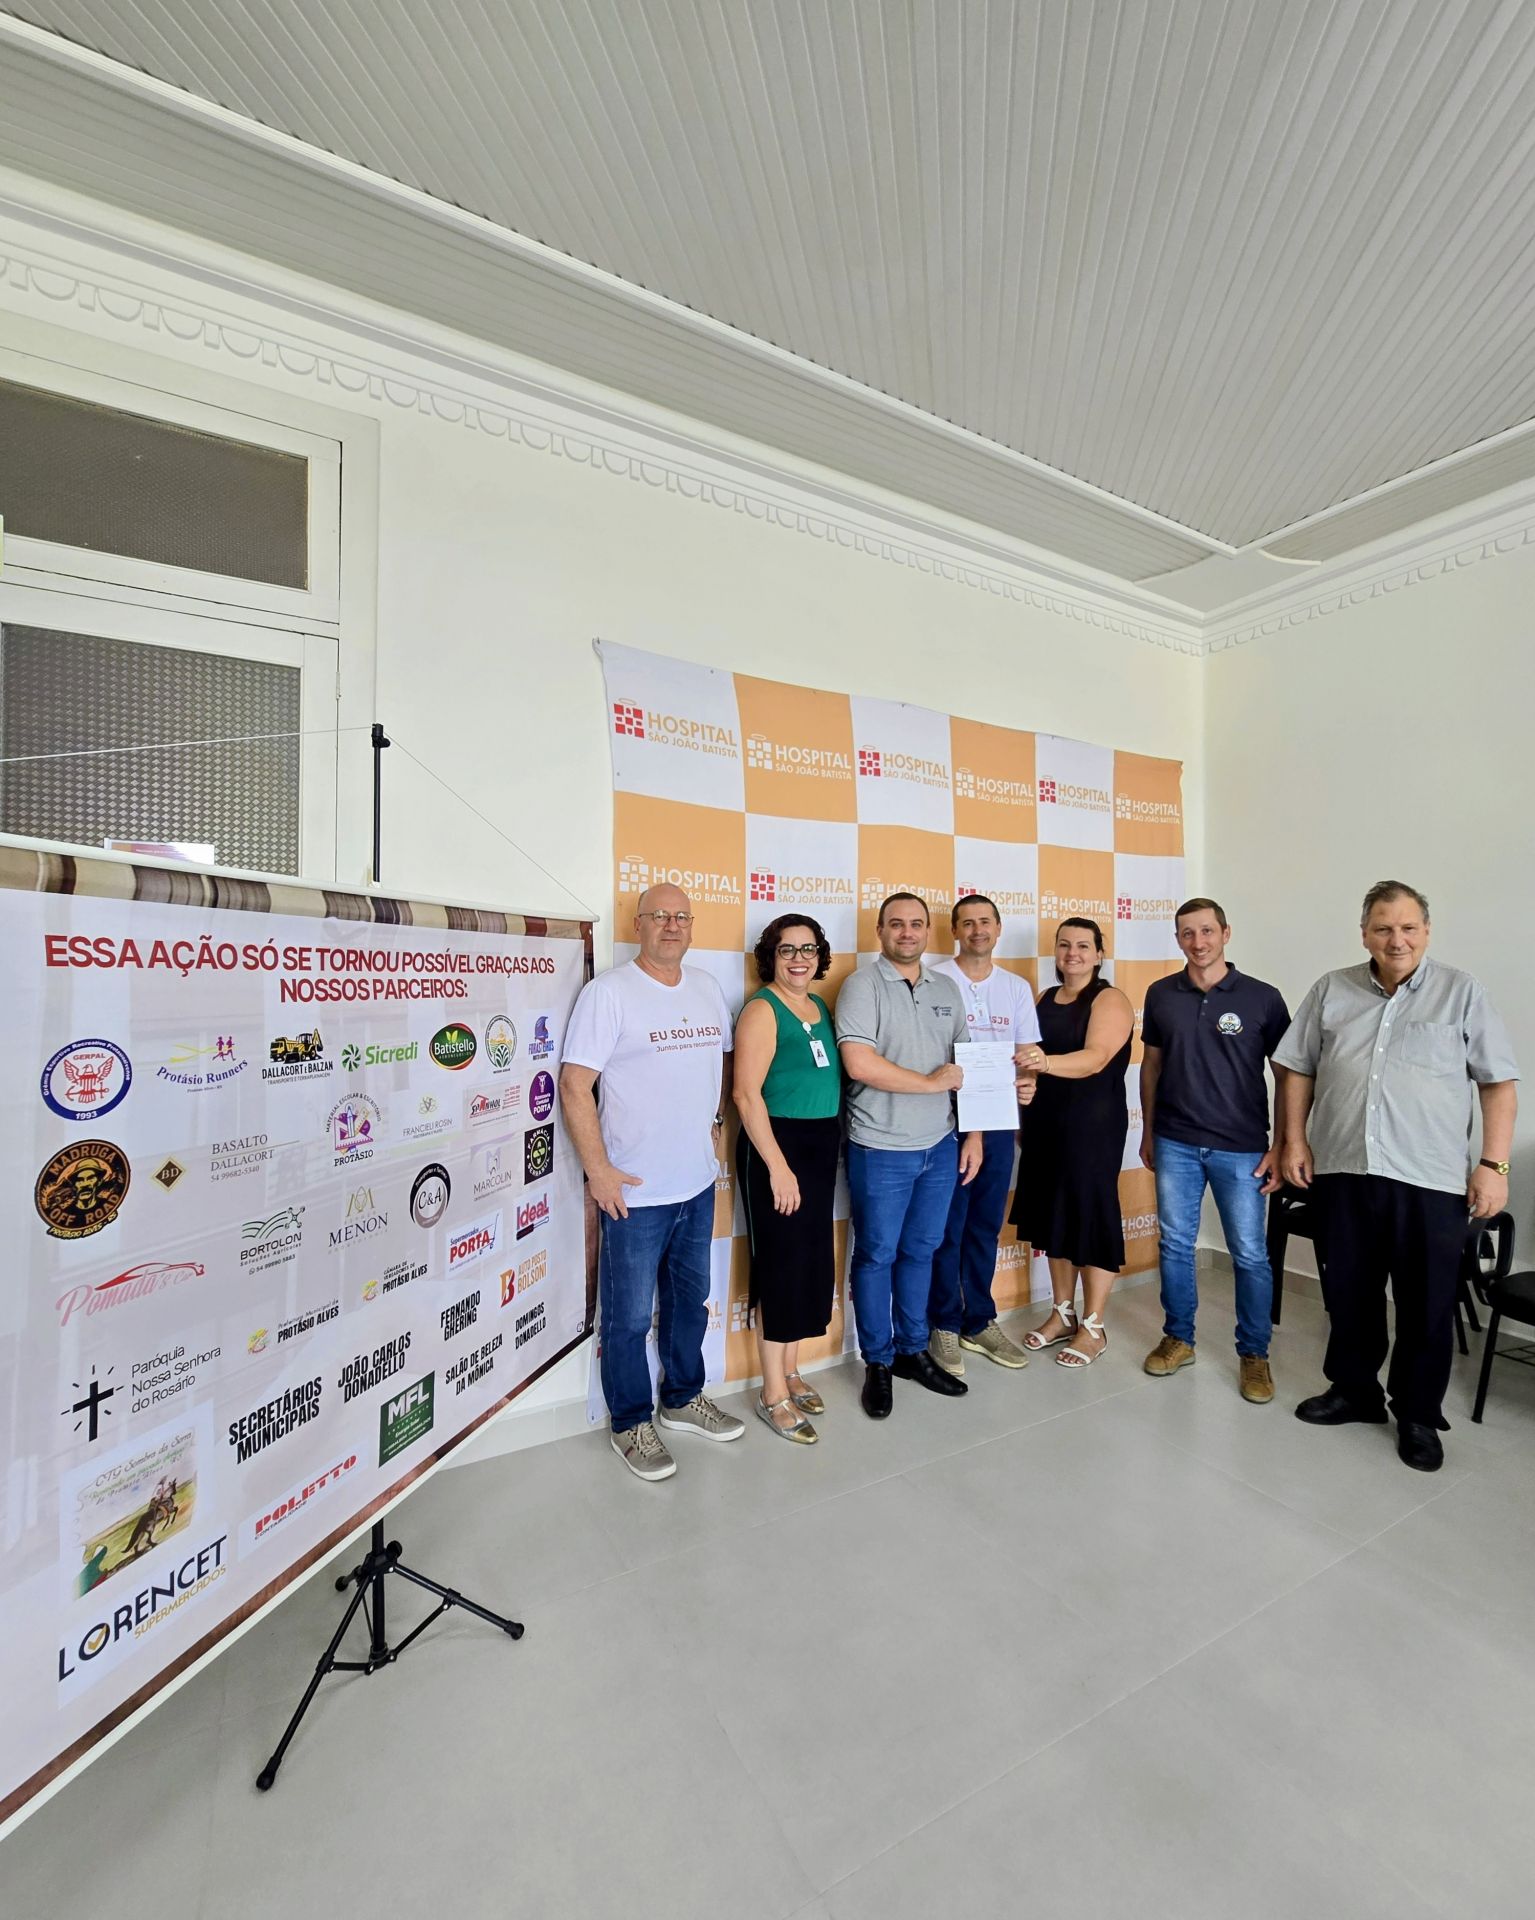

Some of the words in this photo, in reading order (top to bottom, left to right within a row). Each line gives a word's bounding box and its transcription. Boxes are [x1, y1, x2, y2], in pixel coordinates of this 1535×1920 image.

[648, 712, 738, 747] HOSPITAL
[649, 732, 669, 744] SÃO
[672, 738, 699, 751] JOÃO
[702, 744, 738, 759] BATISTA
[776, 744, 852, 770] HOSPITAL
[775, 763, 793, 774] SÃO
[795, 765, 819, 777] JOÃO
[821, 770, 852, 780] BATISTA
[883, 753, 949, 780] HOSPITAL
[883, 770, 899, 779] SÃO
[901, 772, 921, 784] JOÃO
[922, 778, 949, 789] BATISTA
[976, 776, 1034, 797] HOSPITAL
[977, 792, 991, 801] SÃO
[992, 794, 1010, 805] JOÃO
[1011, 798, 1034, 807] BATISTA
[1058, 783, 1111, 805] HOSPITAL
[1132, 801, 1180, 817] HOSPITAL
[652, 866, 741, 893] HOSPITAL
[778, 875, 853, 894] HOSPITAL
[704, 894, 740, 905] BATISTA
[778, 892, 795, 903] SÃO
[798, 893, 821, 904] JOÃO
[823, 896, 853, 905] BATISTA
[1060, 897, 1112, 914] HOSPITAL
[44, 934, 144, 969] ESSA
[147, 935, 238, 977] AÇÃO
[242, 938, 279, 971] SÓ
[282, 947, 312, 971] SE
[315, 947, 399, 973] TORNOU
[402, 948, 474, 973] POSSÍVEL
[476, 956, 529, 978] GRAÇAS
[531, 957, 555, 973] AOS
[280, 978, 370, 1003] NOSSOS
[373, 978, 468, 1000] PARCEIROS:
[991, 1016, 1009, 1025] SJB
[434, 1038, 474, 1055] Batistello
[649, 1030, 667, 1042] EU
[671, 1028, 693, 1039] SOU
[696, 1027, 721, 1037] HSJB
[364, 1041, 418, 1065] Sicredi
[156, 1066, 203, 1085] Protásio
[206, 1059, 248, 1084] Runners
[262, 1063, 303, 1079] DALLACORT
[308, 1061, 333, 1073] BALZAN
[75, 1111, 97, 1119] 1993
[326, 1104, 340, 1132] MATERIAL
[340, 1092, 359, 1105] ESCOLAR
[534, 1103, 551, 1114] PORTA
[212, 1134, 268, 1154] BASALTO
[334, 1149, 374, 1166] PROTÁSIO
[49, 1145, 116, 1175] MADRUGA
[211, 1149, 274, 1171] DALLACORT
[160, 1167, 180, 1181] BD
[474, 1170, 512, 1194] MARCOLIN
[50, 1208, 76, 1226] OFF
[84, 1194, 119, 1224] ROAD
[419, 1186, 441, 1209] C&A
[517, 1193, 549, 1230] Ideal
[329, 1212, 388, 1247] MENON
[241, 1232, 301, 1260] BORTOLON
[450, 1230, 490, 1264] PORTA
[531, 1249, 547, 1264] POSTO
[997, 1244, 1027, 1262] PITAL
[383, 1273, 410, 1294] PROTÁSIO
[411, 1264, 428, 1280] ALVES
[518, 1262, 547, 1293] BOLSONI
[440, 1290, 481, 1328] FERNANDO
[515, 1302, 544, 1332] DOMINGOS
[278, 1316, 314, 1344] PROTÁSIO
[317, 1305, 339, 1325] ALVES
[444, 1308, 477, 1342] GHERING
[515, 1317, 546, 1350] DONADELLO
[132, 1346, 185, 1378] Paróquia
[132, 1370, 171, 1396] Nossa
[174, 1347, 221, 1376] Senhora
[338, 1355, 368, 1388] JOÃO
[372, 1331, 411, 1367] CARLOS
[446, 1355, 468, 1384] SALÃO
[470, 1349, 479, 1365] DE
[480, 1333, 503, 1359] BELEZA
[344, 1352, 405, 1404] DONADELLO
[456, 1379, 466, 1396] DA
[467, 1356, 494, 1387] MÔNICA
[131, 1397, 149, 1414] do
[152, 1375, 195, 1404] Rosário
[388, 1382, 430, 1426] MFL
[229, 1376, 322, 1446] SECRETÁRIOS
[237, 1397, 320, 1465] MUNICIPAIS
[255, 1455, 356, 1535] POLETTO
[59, 1534, 227, 1682] LORENCET
[134, 1564, 226, 1640] SUPERMERCADOS
